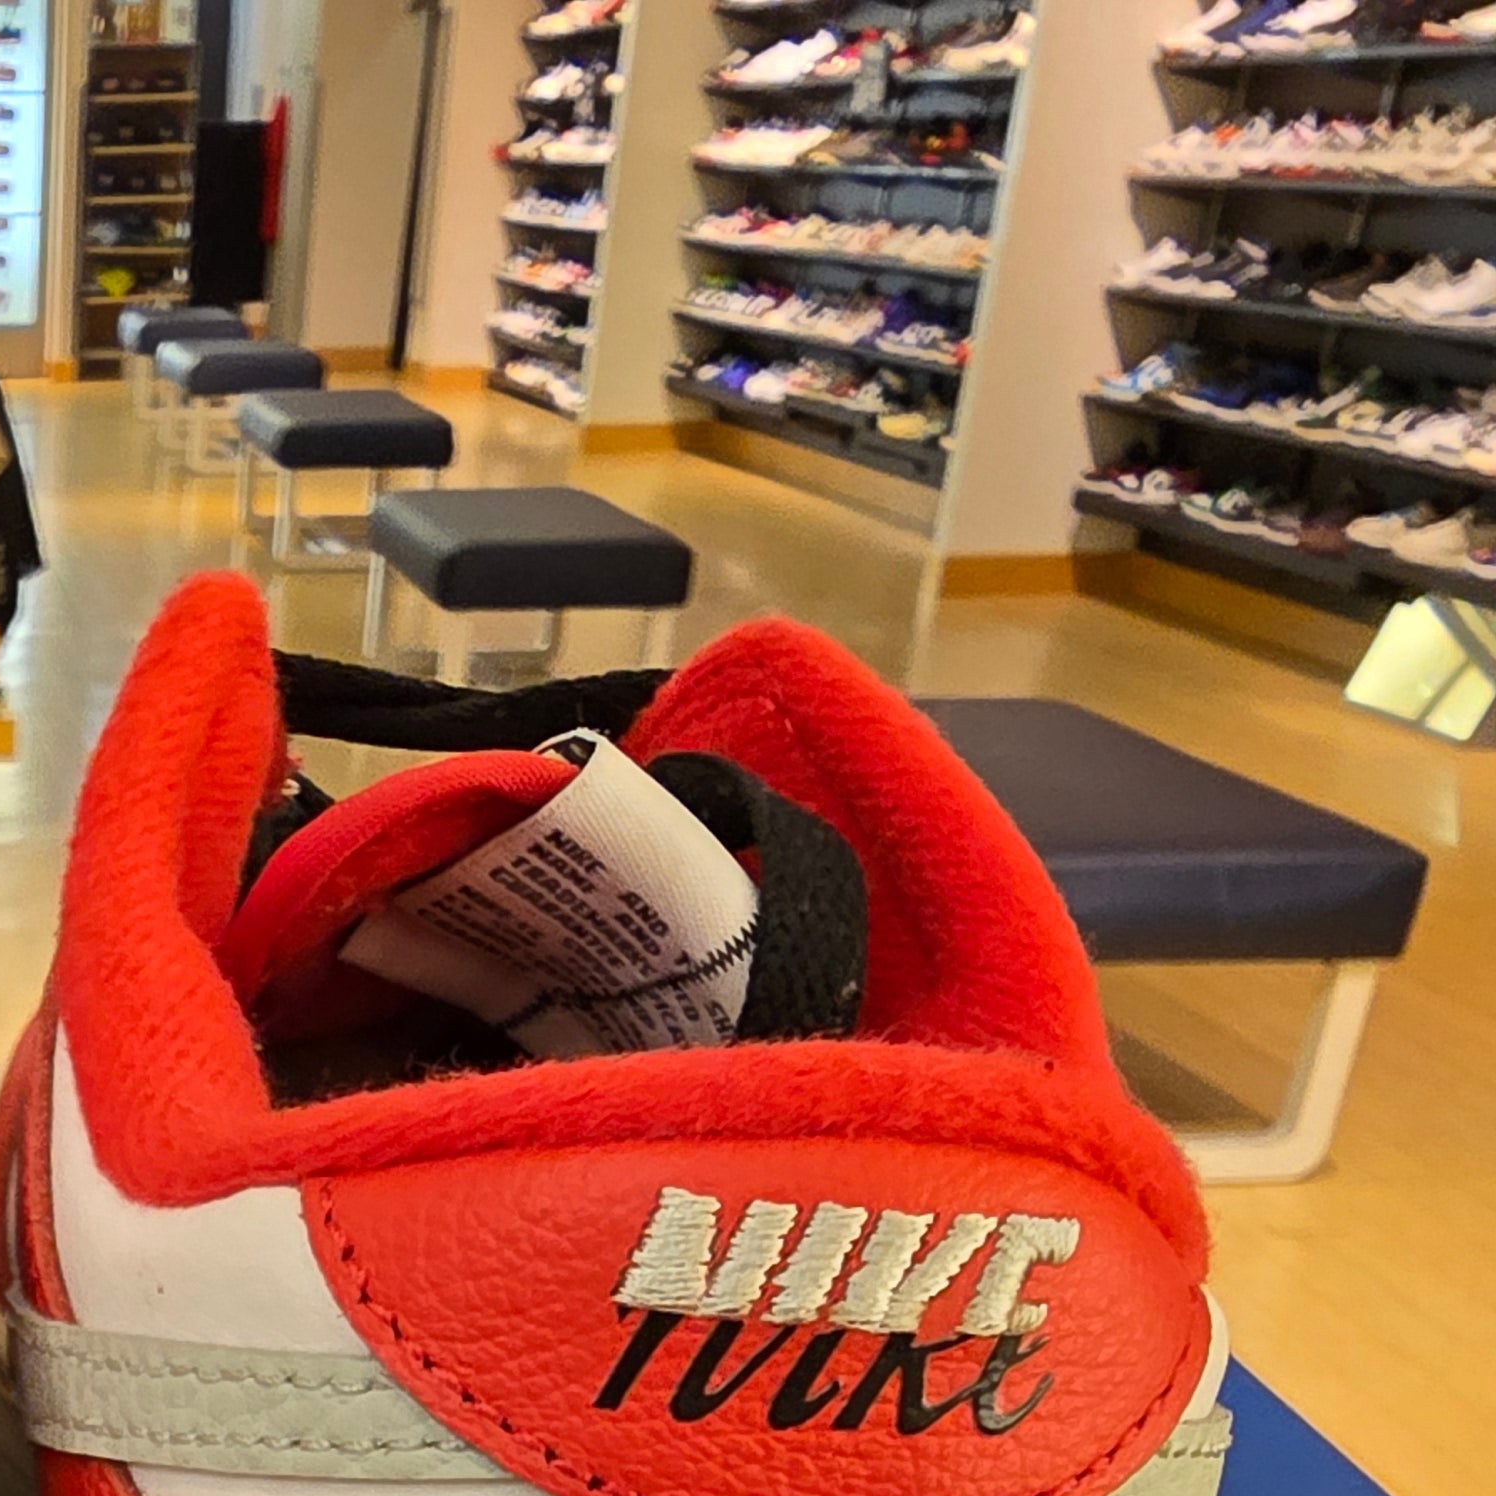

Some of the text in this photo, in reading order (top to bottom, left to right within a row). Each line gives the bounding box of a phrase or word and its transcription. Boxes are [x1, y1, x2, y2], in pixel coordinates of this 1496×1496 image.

[544, 828, 670, 938] NIKE AND
[614, 912, 662, 957] AND
